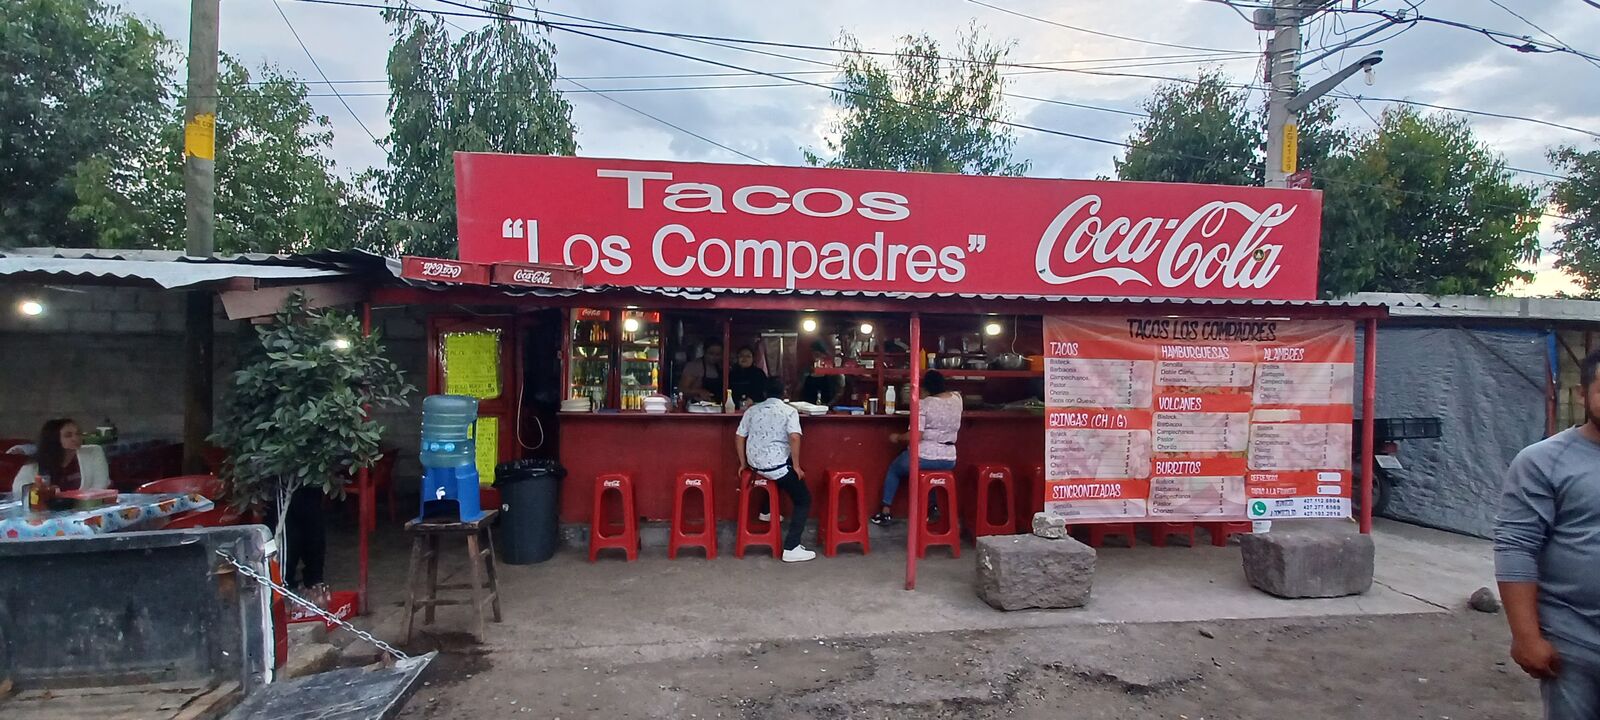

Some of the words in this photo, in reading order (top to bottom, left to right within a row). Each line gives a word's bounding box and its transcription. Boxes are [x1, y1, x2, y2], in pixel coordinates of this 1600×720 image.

[597, 168, 911, 222] Tacos
[1035, 194, 1298, 289] Coca-Cola
[652, 223, 987, 289] Compadres”
[1127, 318, 1170, 340] TACOS
[1173, 320, 1199, 340] LOS
[1202, 321, 1277, 342] COMPADRES
[1049, 342, 1079, 356] TACOS
[1161, 345, 1230, 360] HAMBURGUESAS
[1263, 347, 1304, 361] ALAMBRES
[1158, 396, 1202, 410] VOLCANES
[1049, 413, 1088, 427] GRINGAS
[1155, 461, 1201, 475] BURRITOS
[1052, 483, 1121, 499] SINCRONIZADAS
